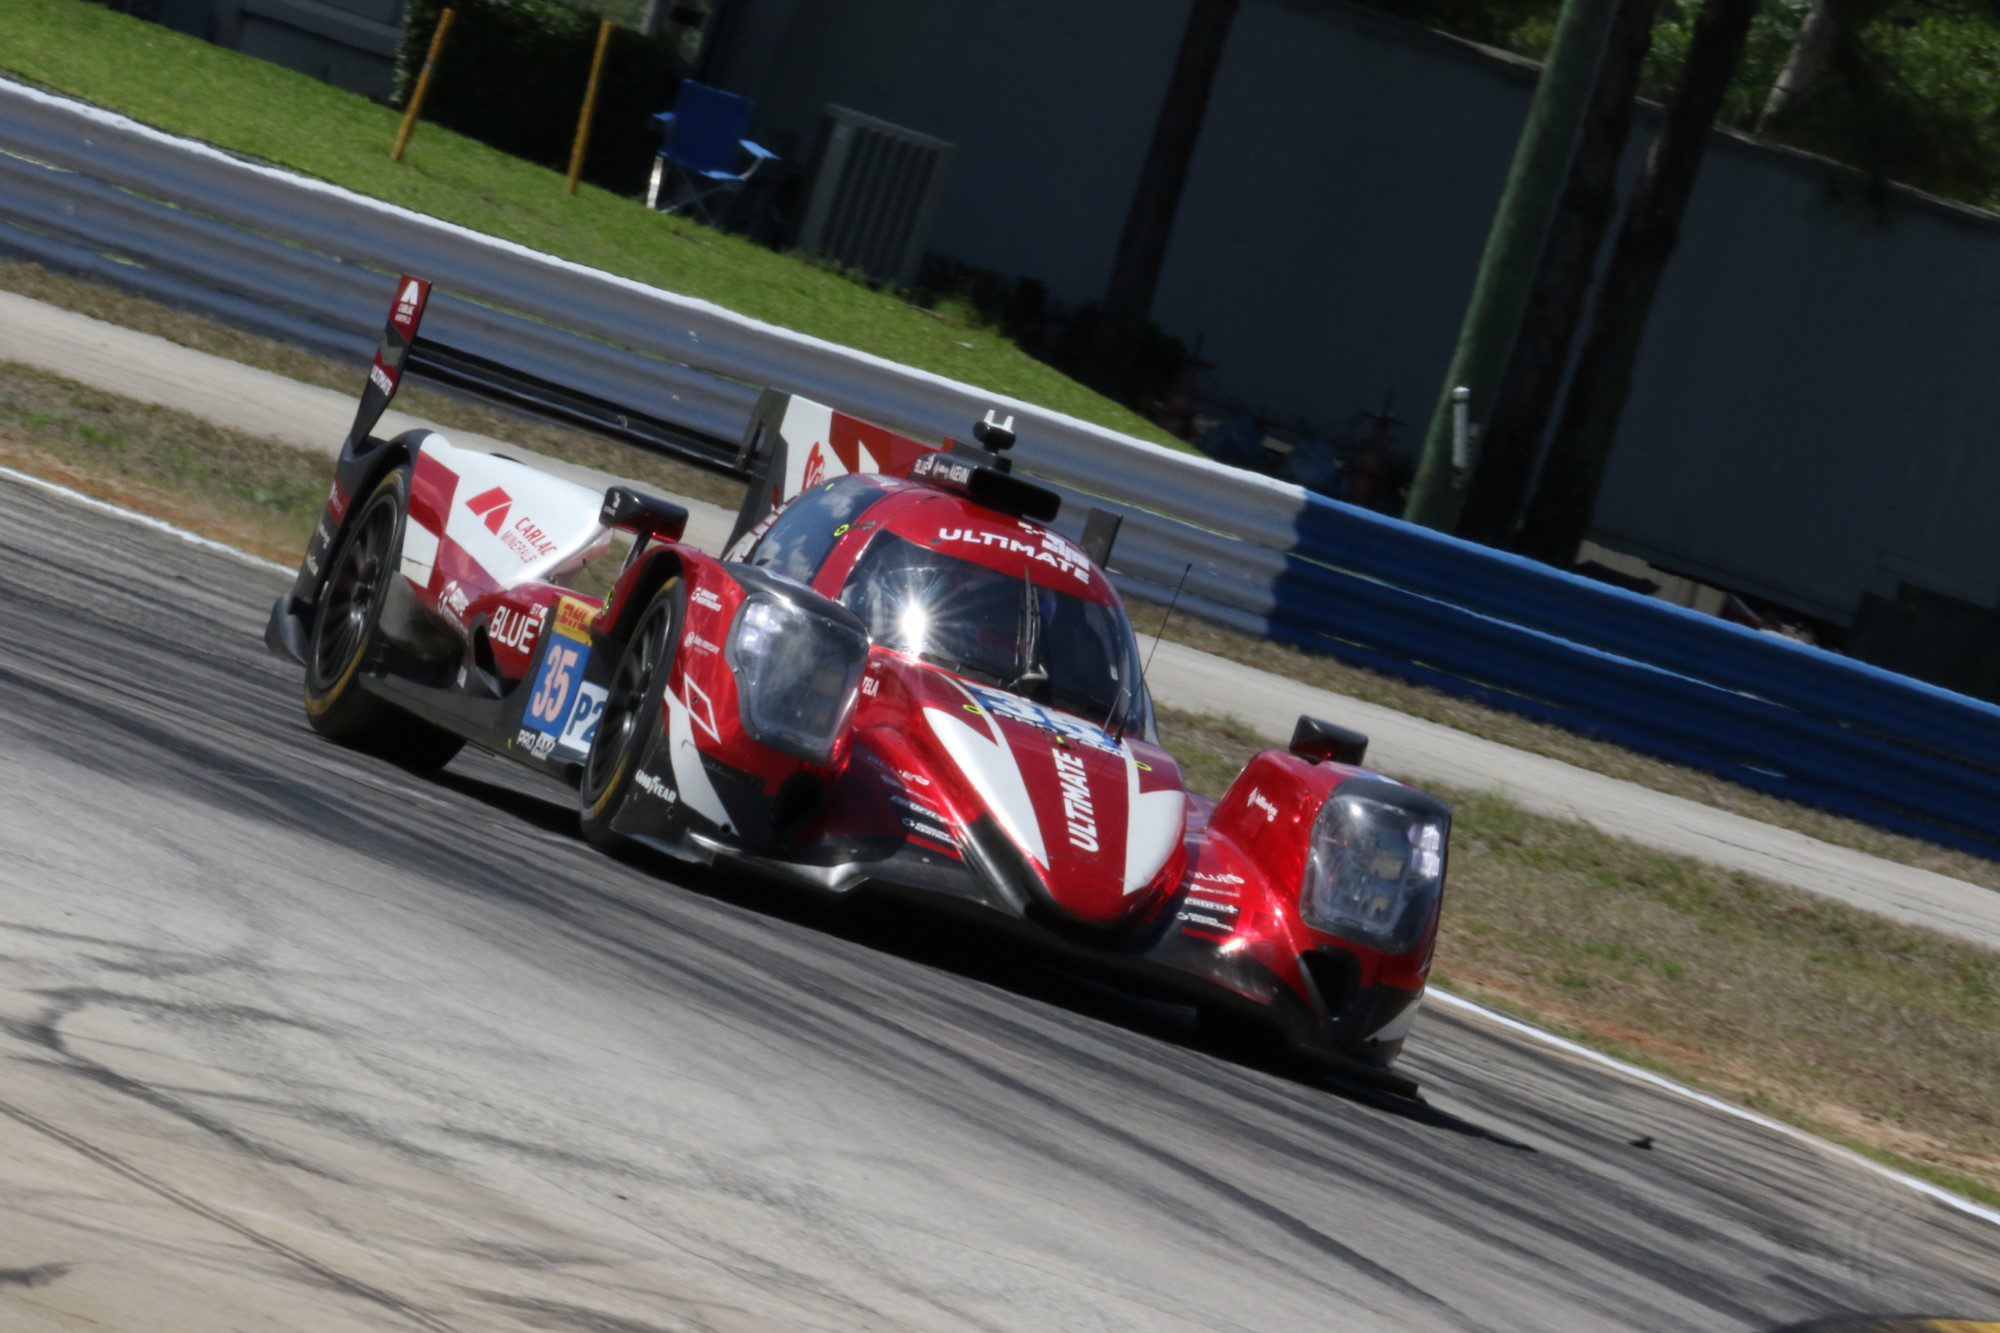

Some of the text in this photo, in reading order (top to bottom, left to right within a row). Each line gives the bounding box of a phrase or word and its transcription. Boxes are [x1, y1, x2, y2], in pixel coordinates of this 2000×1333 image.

[514, 517, 557, 556] CARLAC
[938, 528, 1090, 585] ULTIMATE
[489, 605, 539, 654] BLUE
[531, 644, 578, 723] 35
[1052, 747, 1099, 852] ULTIMATE
